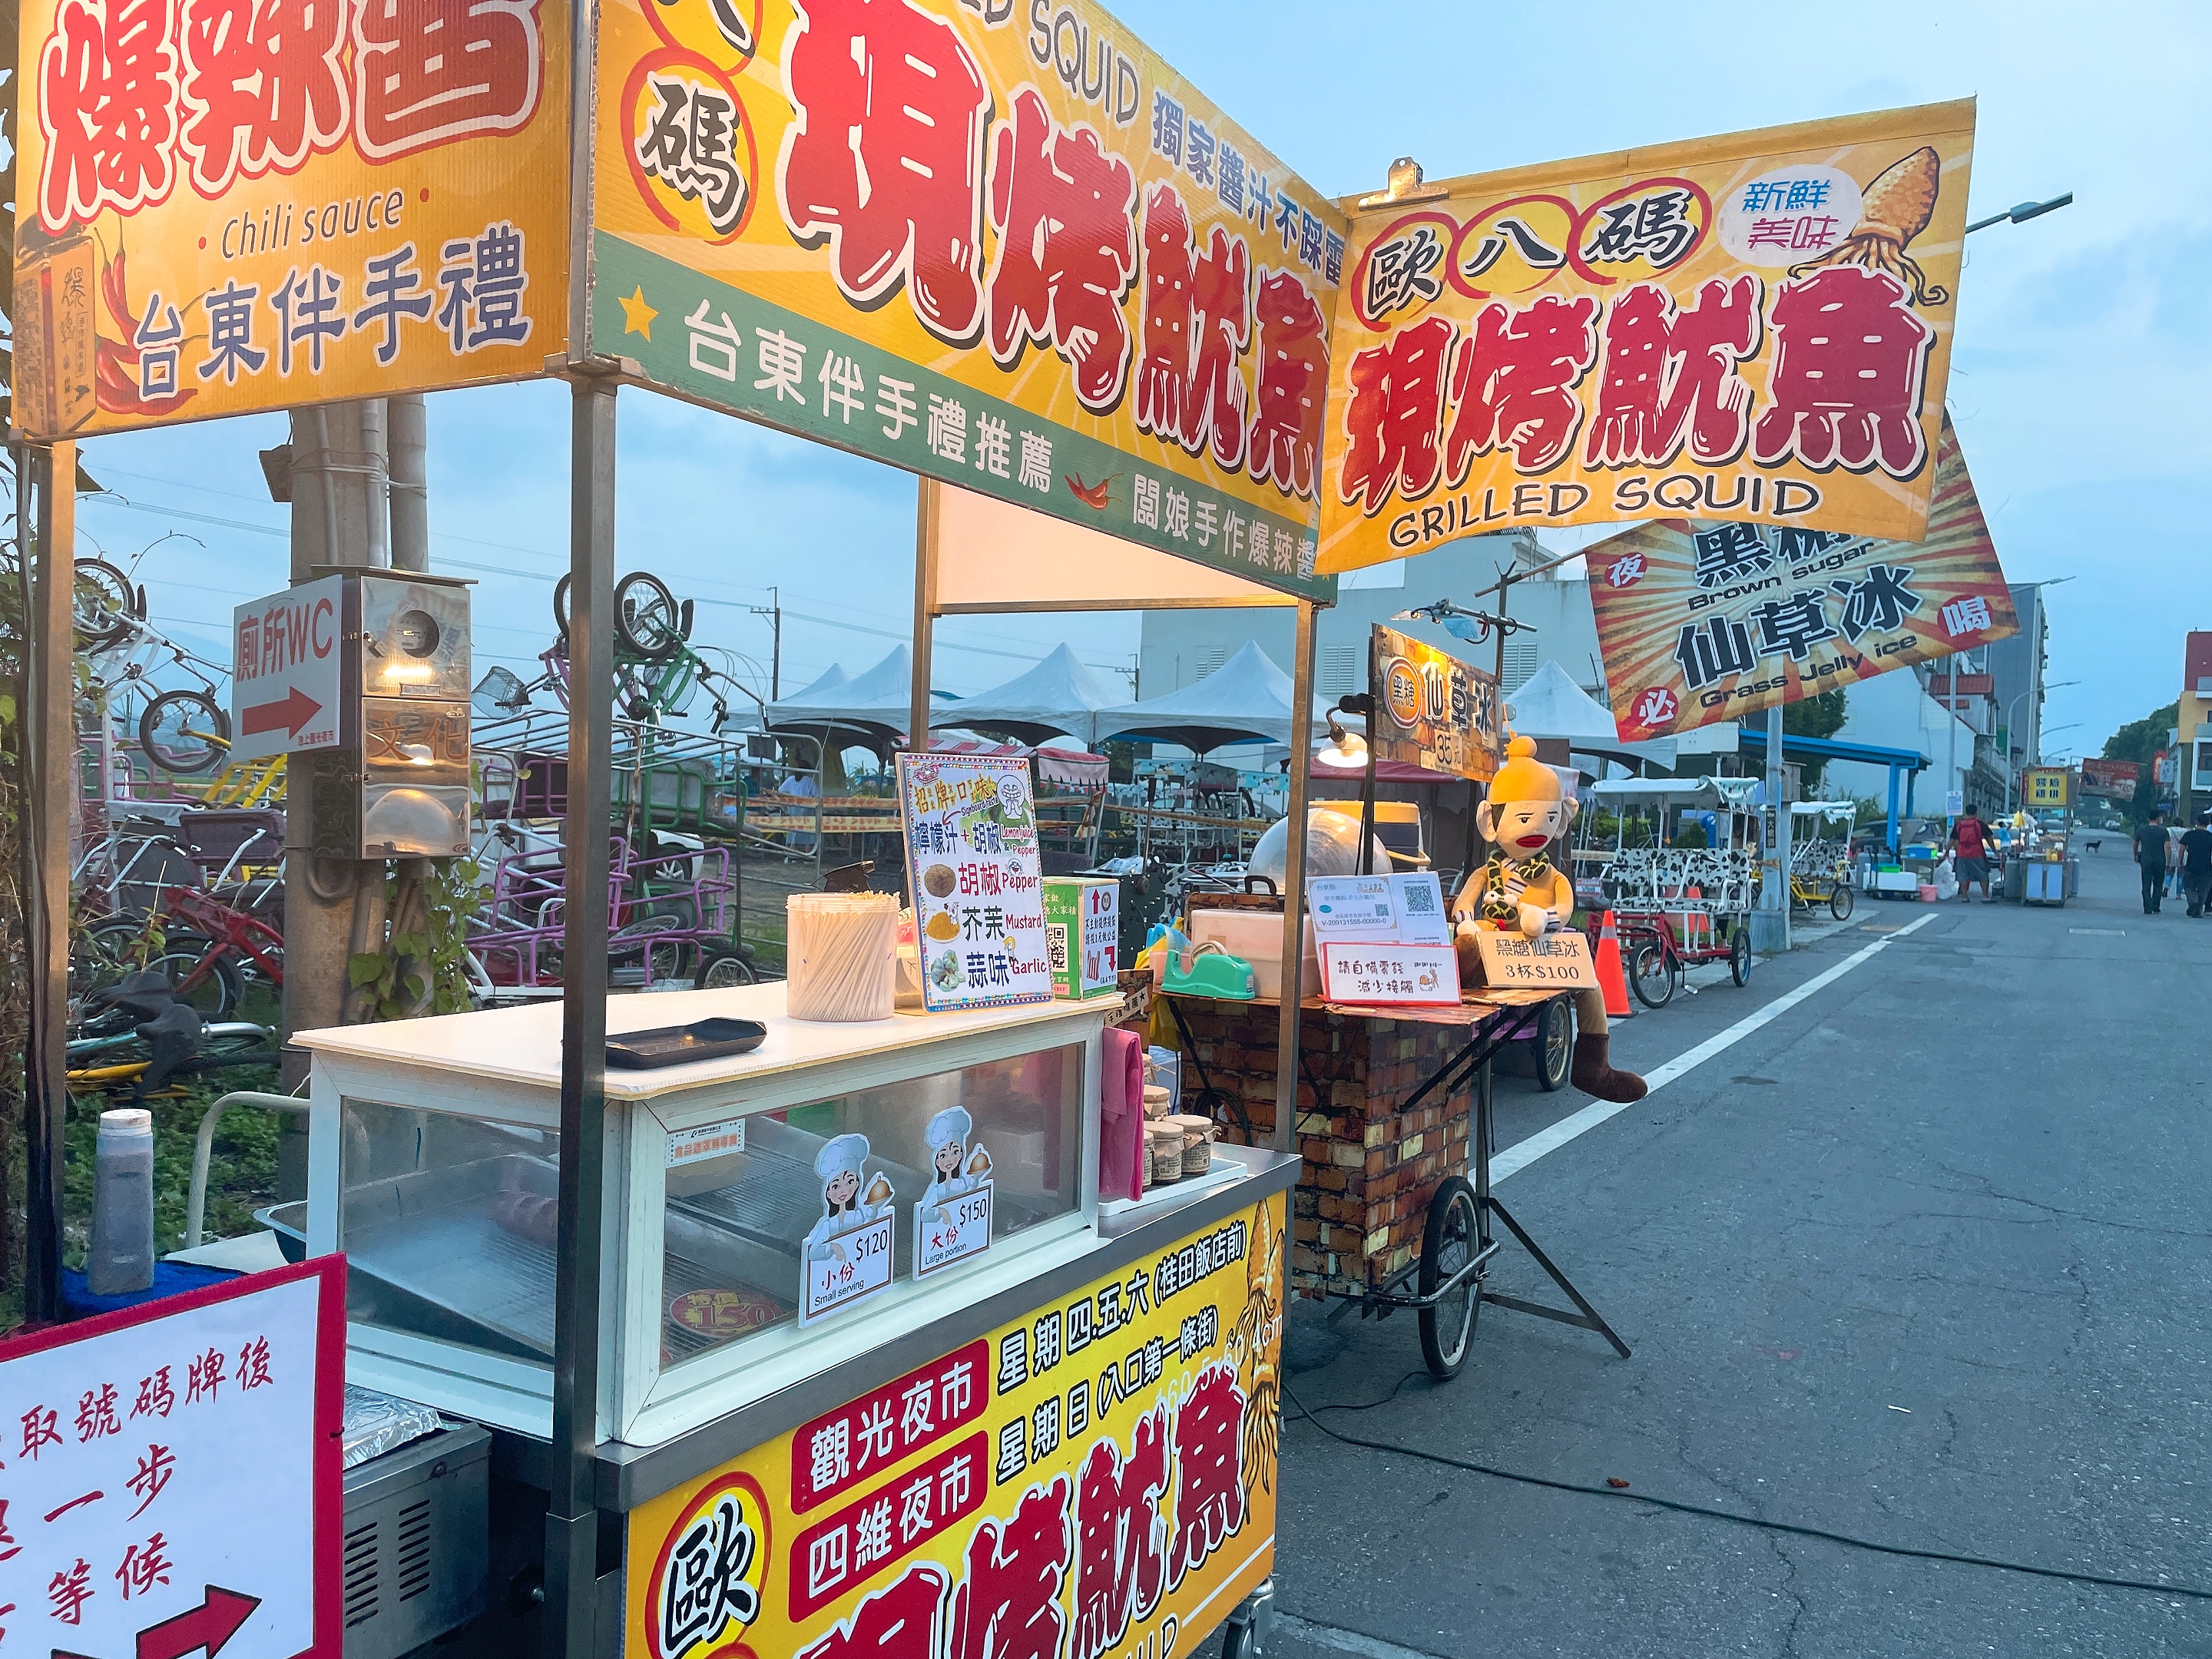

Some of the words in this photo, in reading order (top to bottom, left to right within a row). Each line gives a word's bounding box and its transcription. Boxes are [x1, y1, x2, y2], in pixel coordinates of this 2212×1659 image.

[1029, 0, 1139, 124] SQUID
[635, 0, 757, 235] 碼
[1152, 90, 1344, 287] 獨家醬汁不踩雷
[1741, 178, 1831, 212] 新鮮
[301, 191, 403, 243] sauce
[1747, 214, 1839, 250] 美味
[776, 0, 1329, 507] 現烤魷魚
[1363, 190, 1699, 323] 歐八碼
[134, 219, 535, 402] 台東伴手禮
[684, 298, 1052, 495] 台東伴手禮推薦
[1339, 265, 1934, 516] 現烤魷魚
[1132, 472, 1316, 582] 闆娘手作爆辣醬
[1389, 483, 1589, 548] GRILLED
[1614, 475, 1821, 515] SQUID
[1608, 554, 1645, 588] 夜
[1687, 575, 1783, 611] Brown
[1791, 541, 1875, 581] sugar
[1674, 564, 1923, 692] 仙草冰
[1941, 596, 1992, 638] 喝
[1699, 673, 1789, 708] Grass
[1800, 652, 1864, 682] Jelly
[1874, 635, 1918, 659] ice
[1392, 674, 1416, 708] 黑糖
[1421, 661, 1493, 741] 仙草冰
[1638, 689, 1676, 727] 必
[914, 820, 959, 856] 檸檬汁
[972, 821, 1002, 855] 胡椒
[1001, 824, 1020, 840] Lemon
[1019, 826, 1035, 843] juice
[1012, 844, 1037, 858] Pepper
[958, 861, 1002, 897] 胡椒
[1002, 872, 1038, 894] Pepper
[1005, 913, 1043, 931] Mustard
[1012, 958, 1048, 975] Garlic
[1337, 959, 1405, 975] 請自備零錢
[1495, 938, 1581, 958] 黑糖仙草冰
[966, 950, 1010, 990] 蒜味
[1357, 979, 1414, 995] 減少接觸
[1505, 964, 1580, 981] 3杯$100
[959, 1197, 988, 1228] $150
[856, 1228, 889, 1263] $120
[925, 1251, 945, 1266] Large
[945, 1242, 968, 1260] portion
[930, 1224, 960, 1252] 大份
[814, 1289, 836, 1307] Small
[837, 1279, 865, 1296] serving
[821, 1260, 856, 1291] 小份
[0, 1334, 275, 1469] 取號碼牌後
[810, 1361, 973, 1493] 觀光夜市
[808, 1454, 972, 1599] 四維夜市
[0, 1532, 174, 1650] 等候
[659, 1494, 760, 1659] 歐
